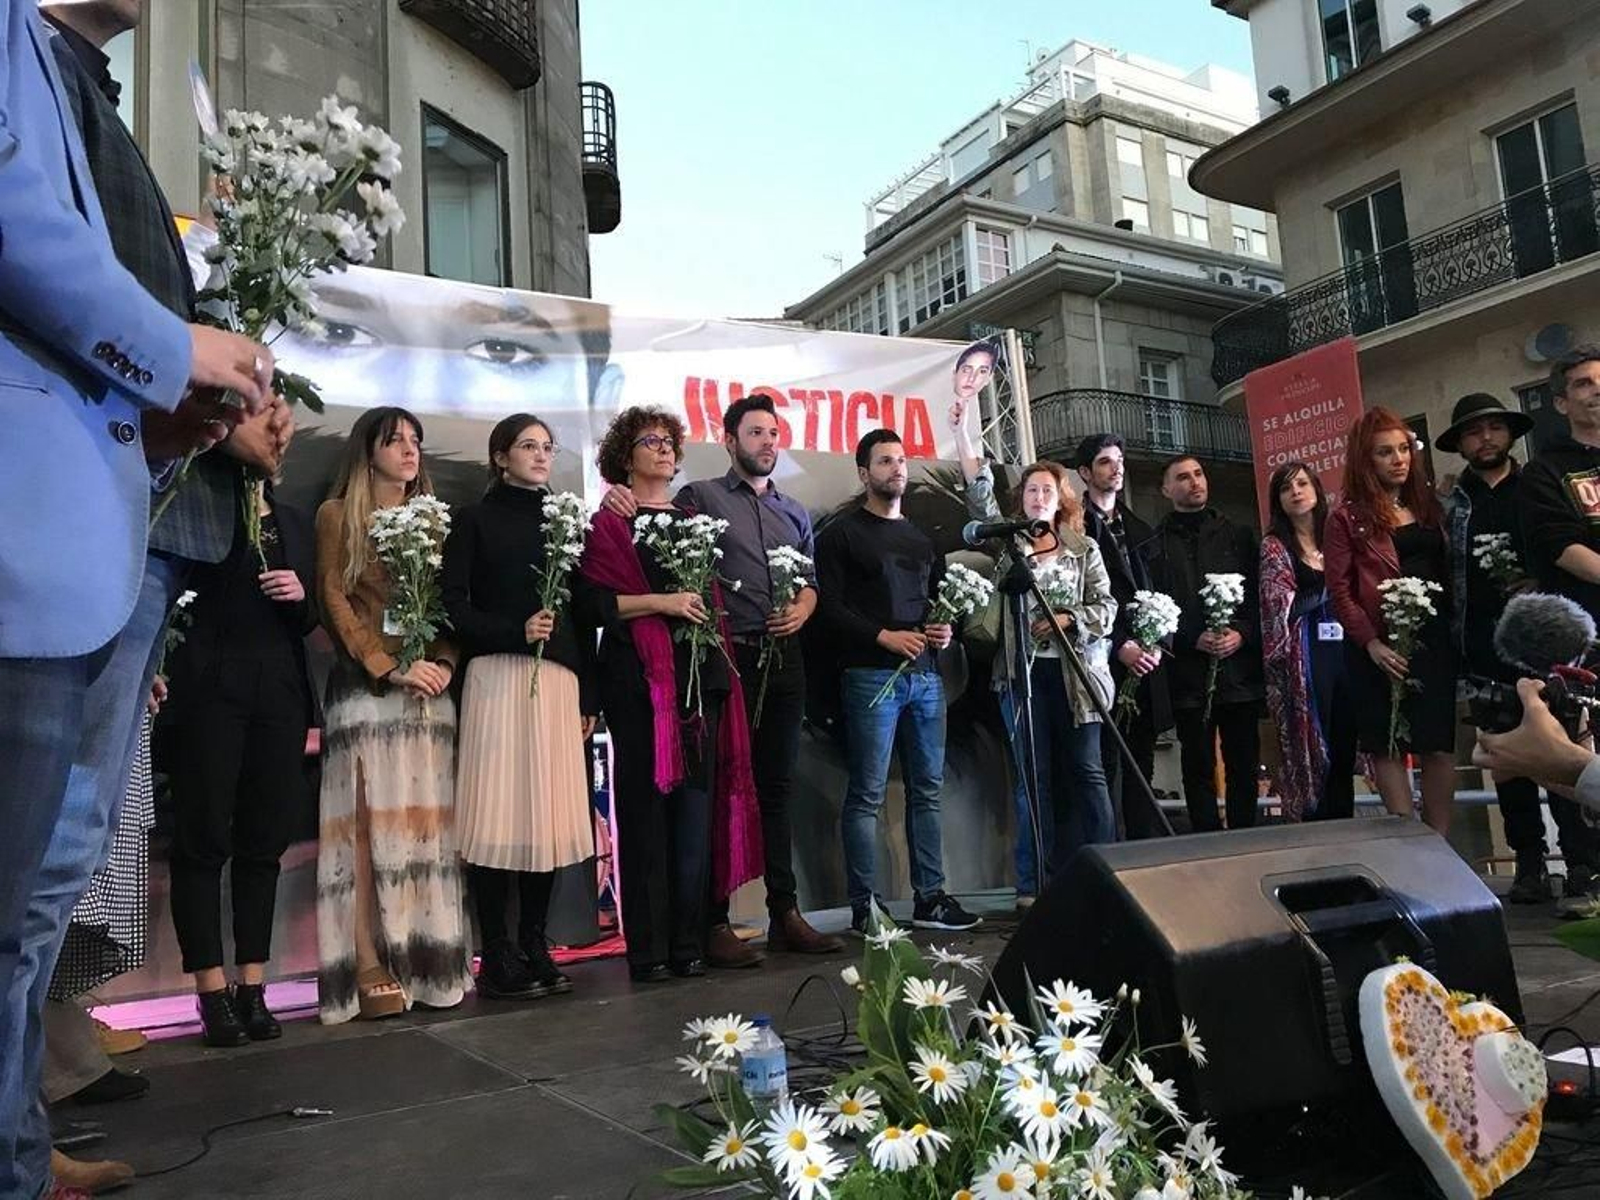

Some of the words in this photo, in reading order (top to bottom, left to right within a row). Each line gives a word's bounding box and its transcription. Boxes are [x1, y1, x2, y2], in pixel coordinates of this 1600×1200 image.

[1263, 417, 1278, 432] SE
[1284, 397, 1345, 425] ALQUILA
[1263, 413, 1349, 452] EDIFICIO
